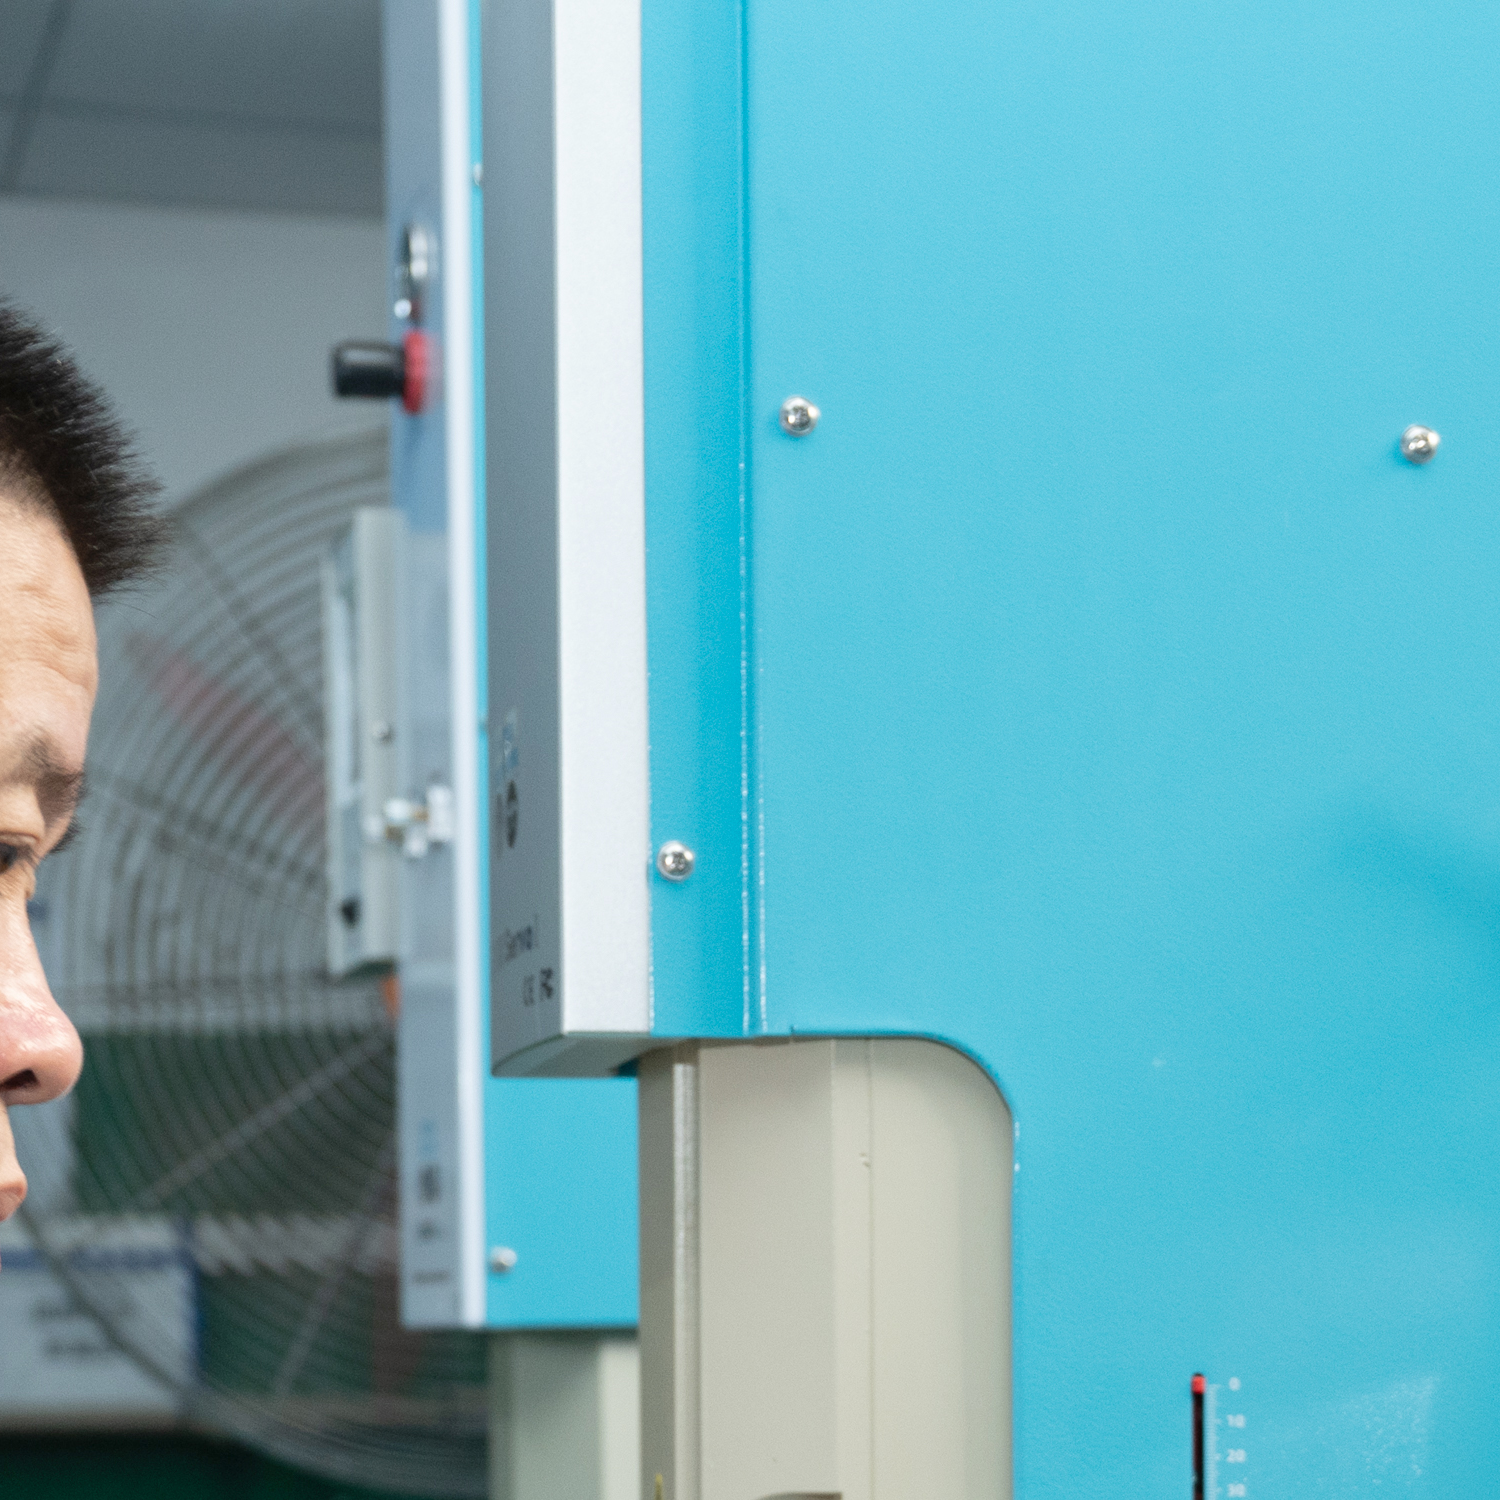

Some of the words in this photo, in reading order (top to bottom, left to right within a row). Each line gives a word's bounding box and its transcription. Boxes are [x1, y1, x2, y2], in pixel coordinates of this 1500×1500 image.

[1229, 1377, 1241, 1391] 0
[1227, 1414, 1246, 1428] 10
[1227, 1449, 1246, 1463] 20
[1228, 1483, 1246, 1497] 30
